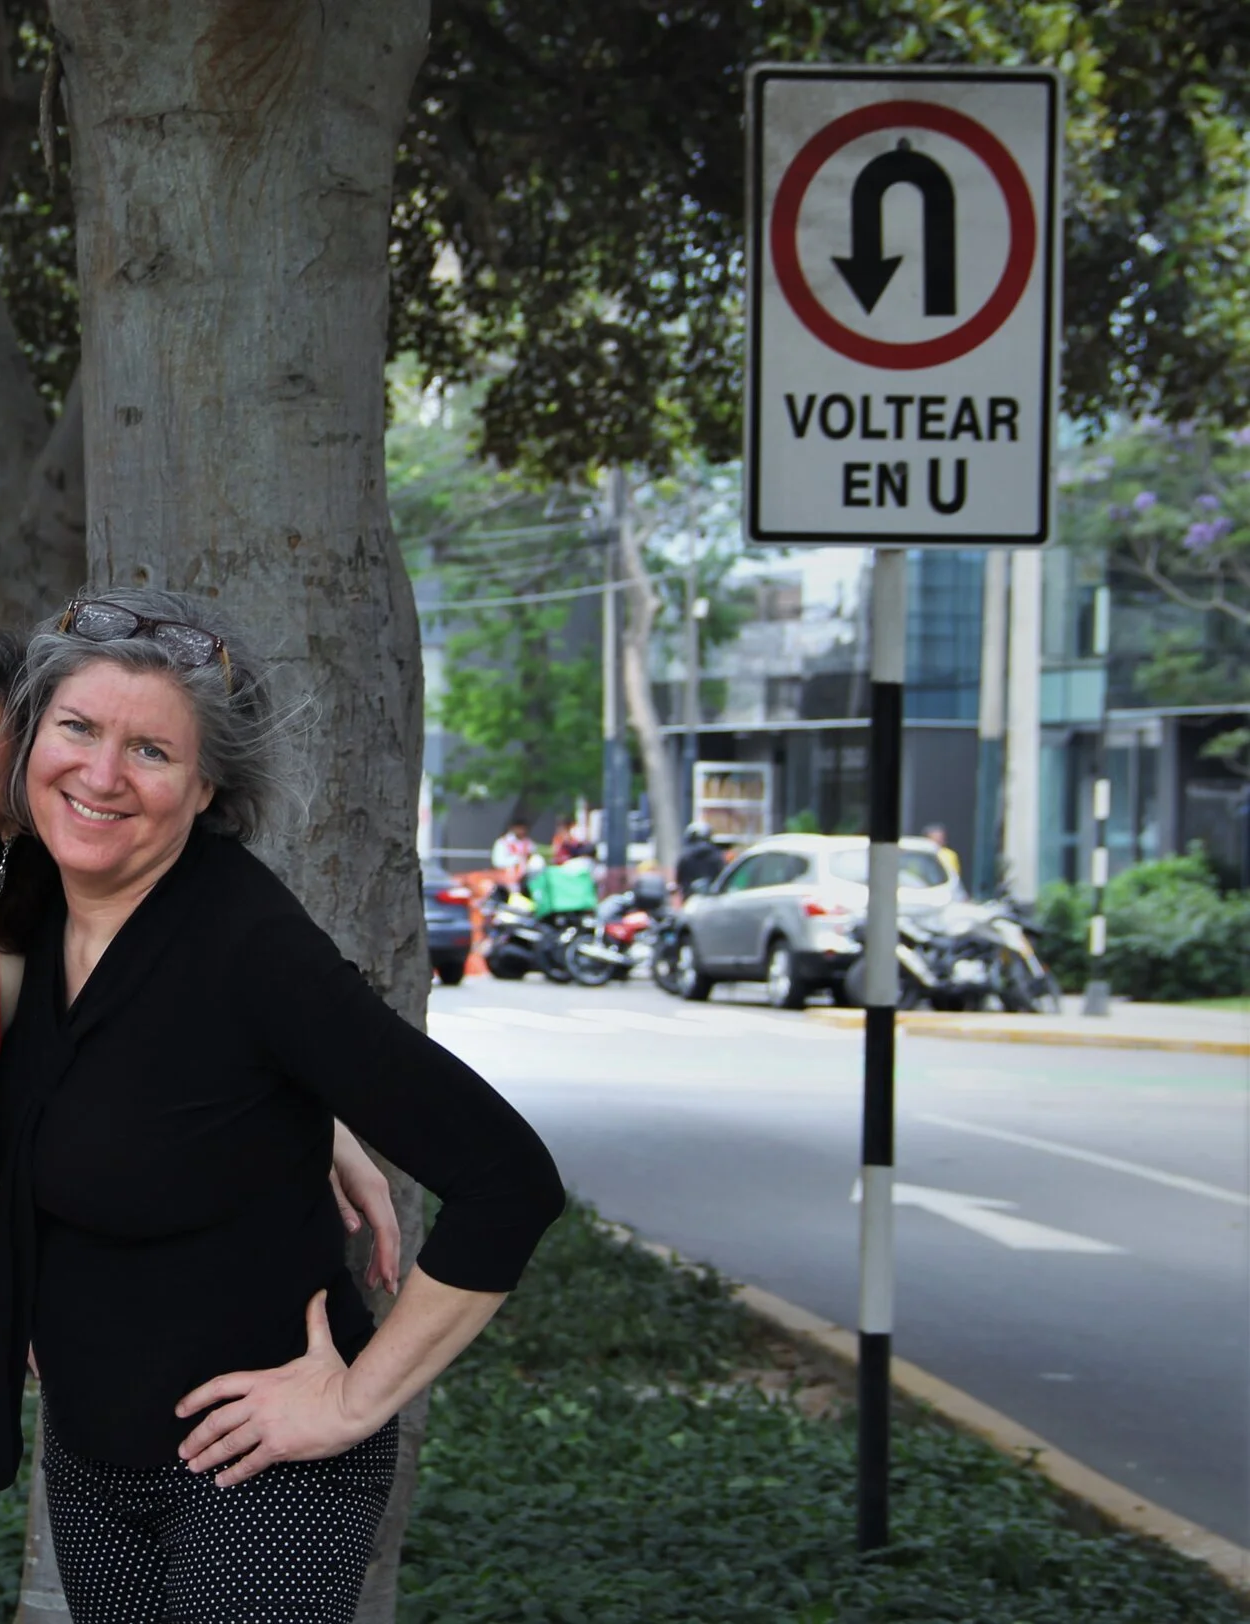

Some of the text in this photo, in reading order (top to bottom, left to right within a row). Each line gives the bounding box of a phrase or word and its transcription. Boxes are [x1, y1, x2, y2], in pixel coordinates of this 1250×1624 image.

[784, 393, 1019, 442] VOLTEAR
[842, 457, 968, 516] EN U
